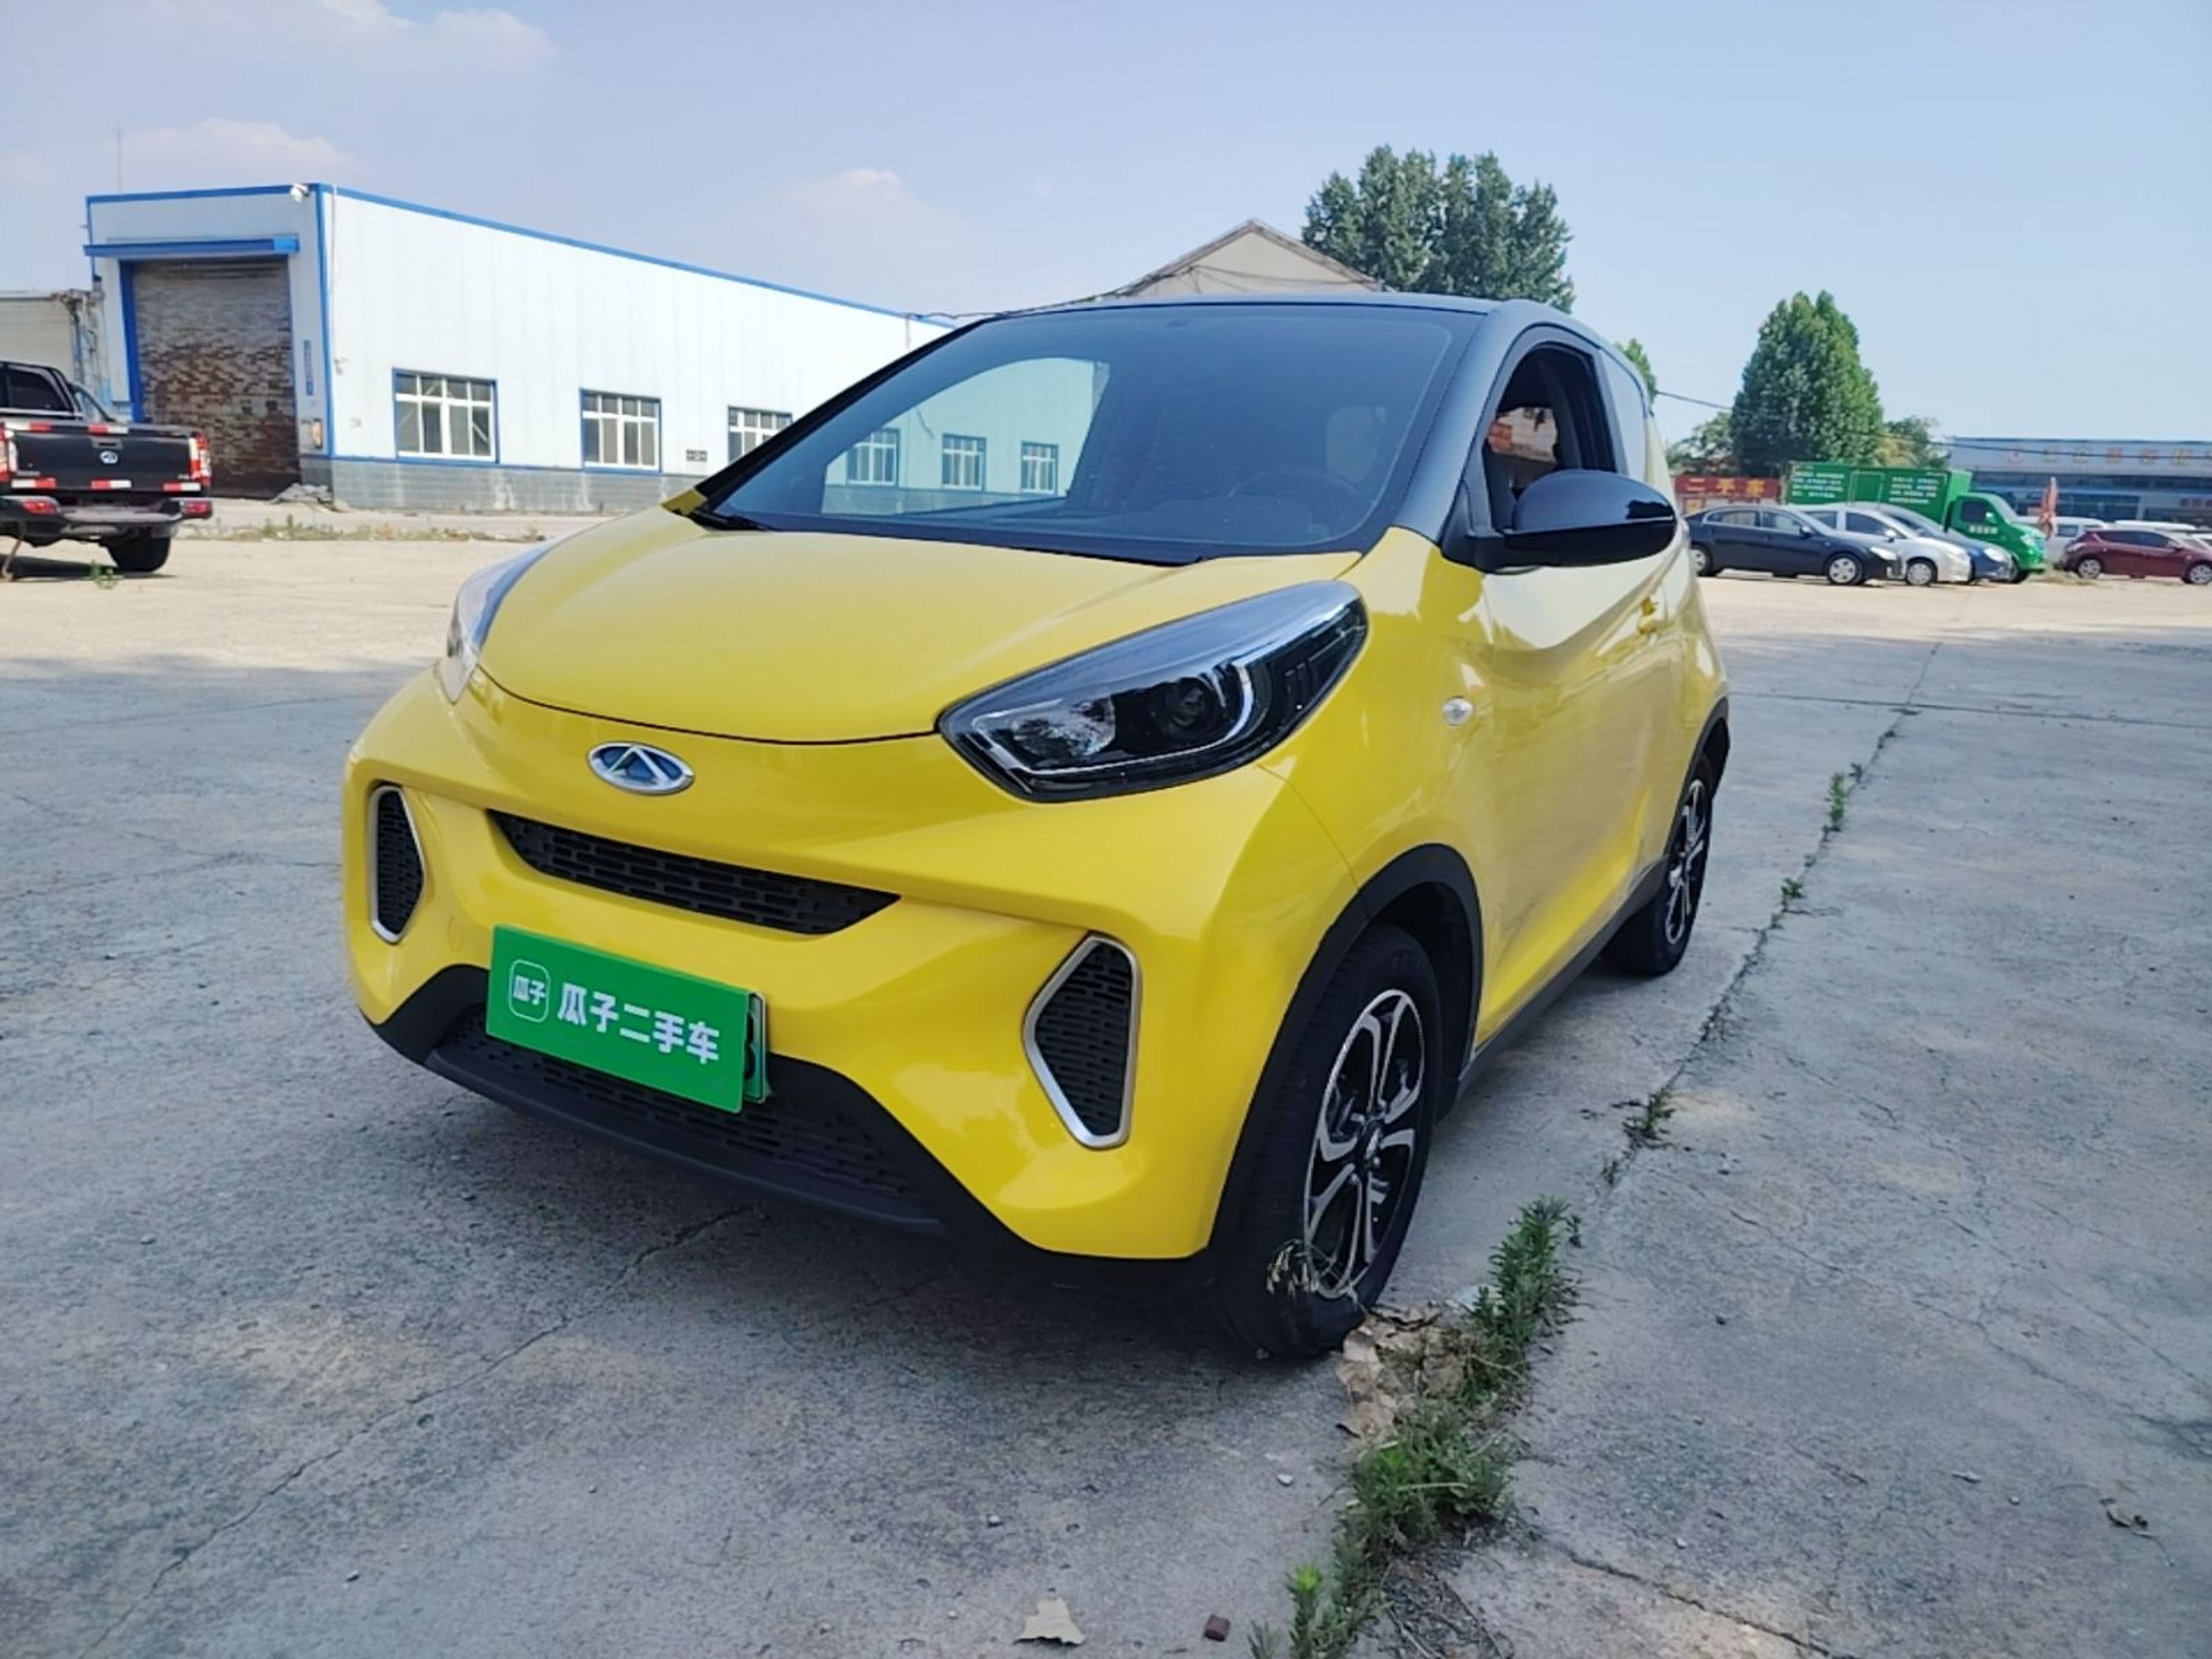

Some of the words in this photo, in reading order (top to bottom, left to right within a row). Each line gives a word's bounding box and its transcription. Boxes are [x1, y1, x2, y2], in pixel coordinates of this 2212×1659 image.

[513, 975, 546, 1006] 瓜子
[557, 982, 719, 1065] 瓜子二手车
